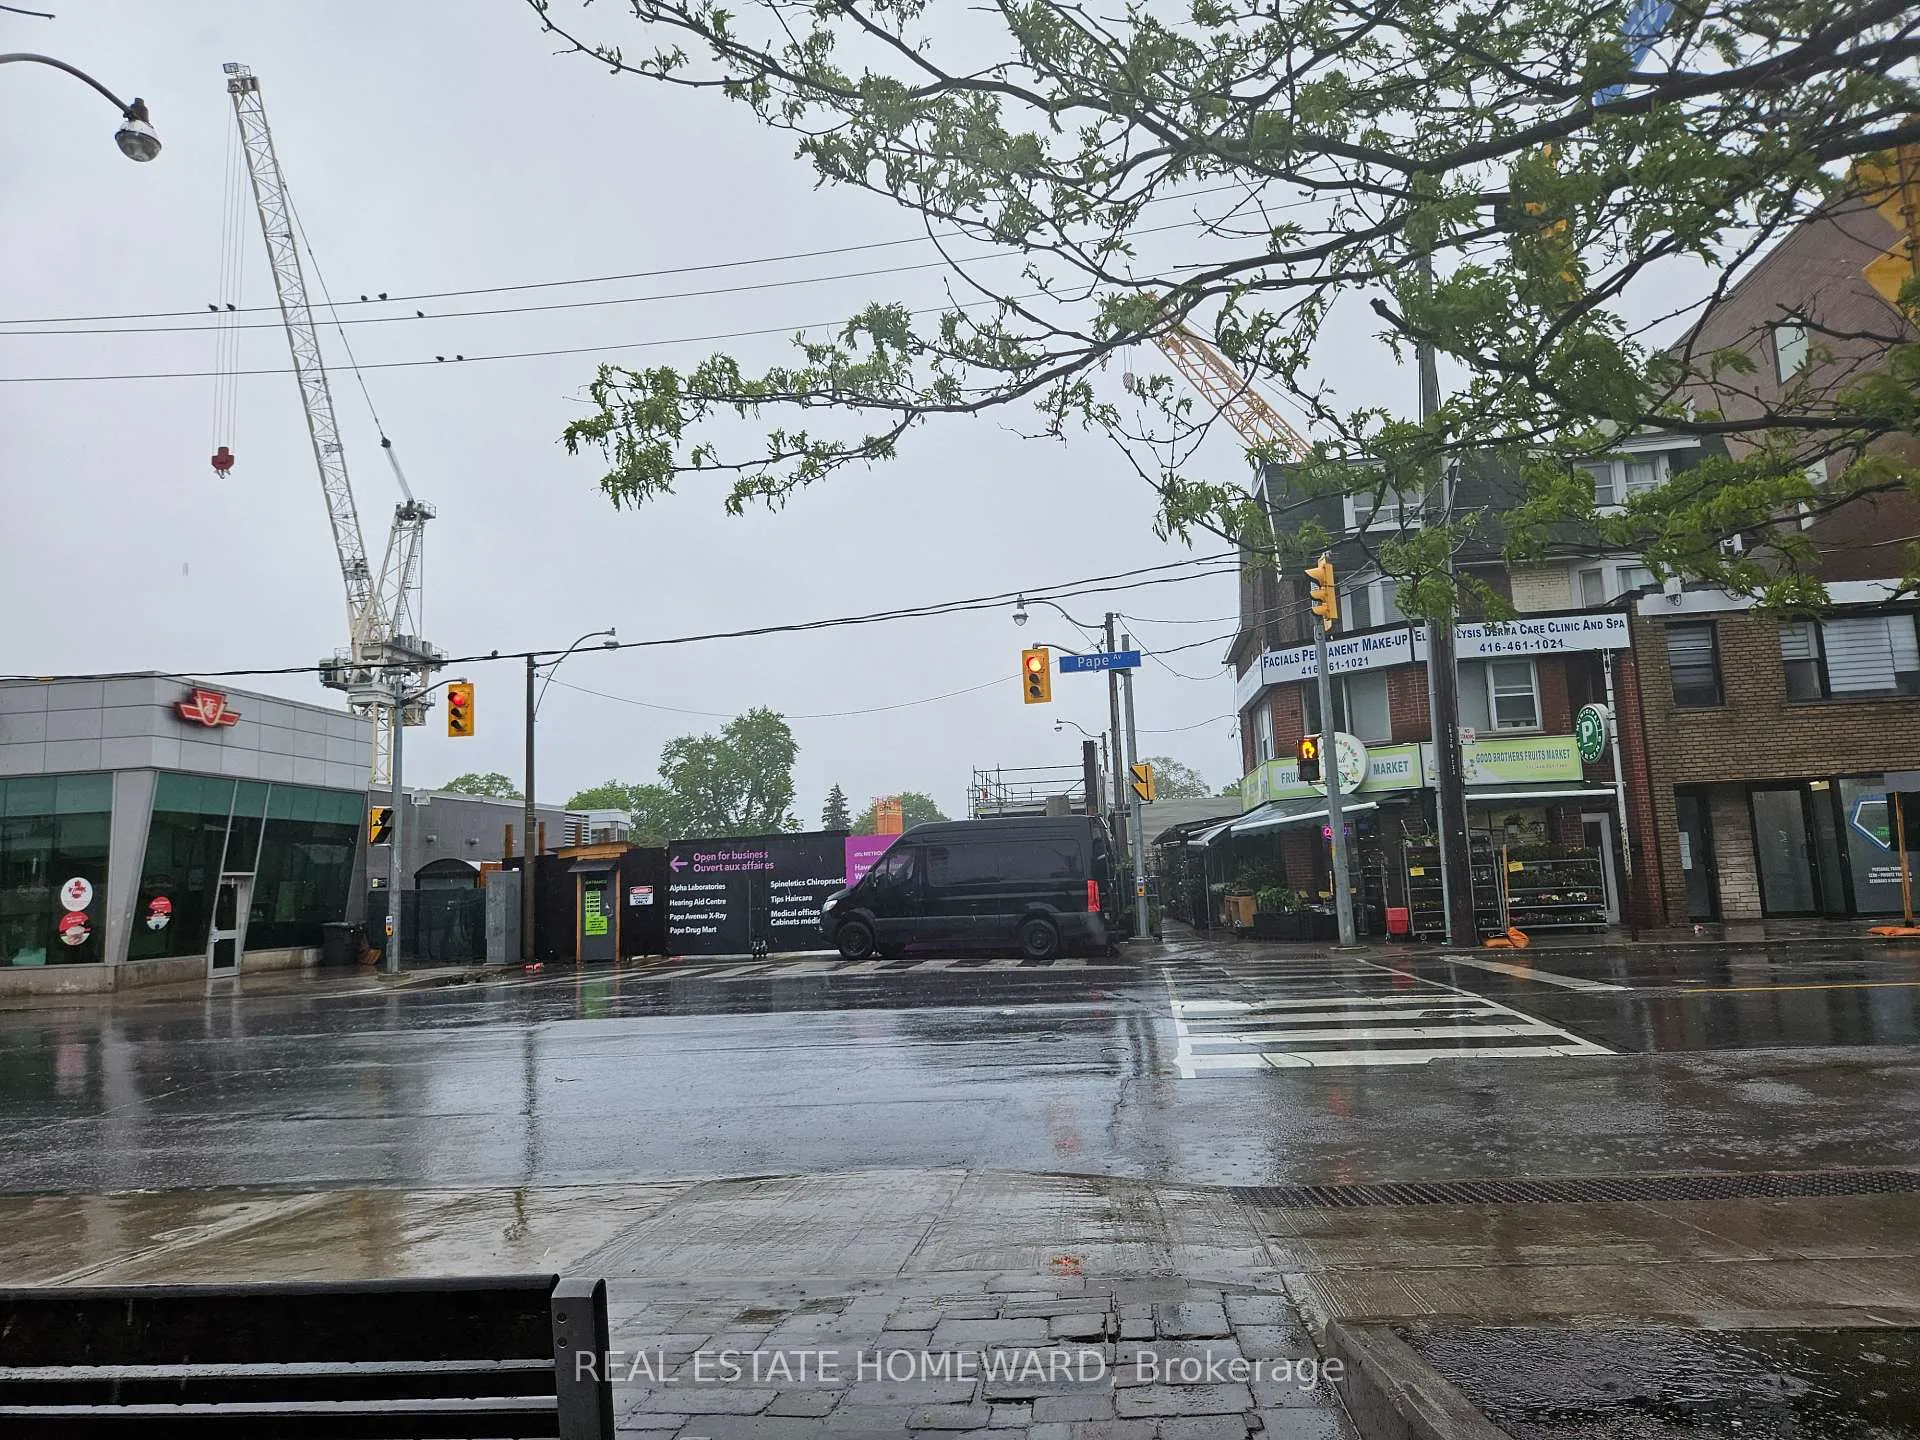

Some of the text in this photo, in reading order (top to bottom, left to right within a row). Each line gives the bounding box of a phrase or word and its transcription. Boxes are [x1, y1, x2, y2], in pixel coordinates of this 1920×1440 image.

[1415, 629, 1482, 642] ELLYSIS
[1519, 623, 1545, 635] CARE
[1548, 621, 1580, 633] CLINIC
[1583, 619, 1603, 631] AND
[1606, 618, 1625, 629] SPA
[1264, 634, 1408, 668] FACIALS PEANENT MAKE-UP
[1480, 639, 1564, 653] 416-461-1021
[1077, 656, 1109, 669] Pape
[1301, 656, 1369, 675] 41661-1021
[1581, 721, 1593, 743] P
[1476, 749, 1570, 763] GOOD BROTHERS FRUITS MARKET
[1373, 760, 1409, 775] MARKET
[693, 849, 769, 863] Open for business
[693, 861, 775, 873] Ouvert aux affaires
[669, 882, 726, 893] Alpha Laboratories
[806, 877, 847, 887] Chiropractic
[669, 897, 727, 908] Hearing Aid Centre
[771, 894, 813, 905] Tips Haircare
[669, 911, 727, 922] Pape Avenue X-Ray
[771, 908, 820, 918] Medical offices
[771, 918, 800, 926] Cabinets
[669, 925, 717, 935] Pape Drug Mart
